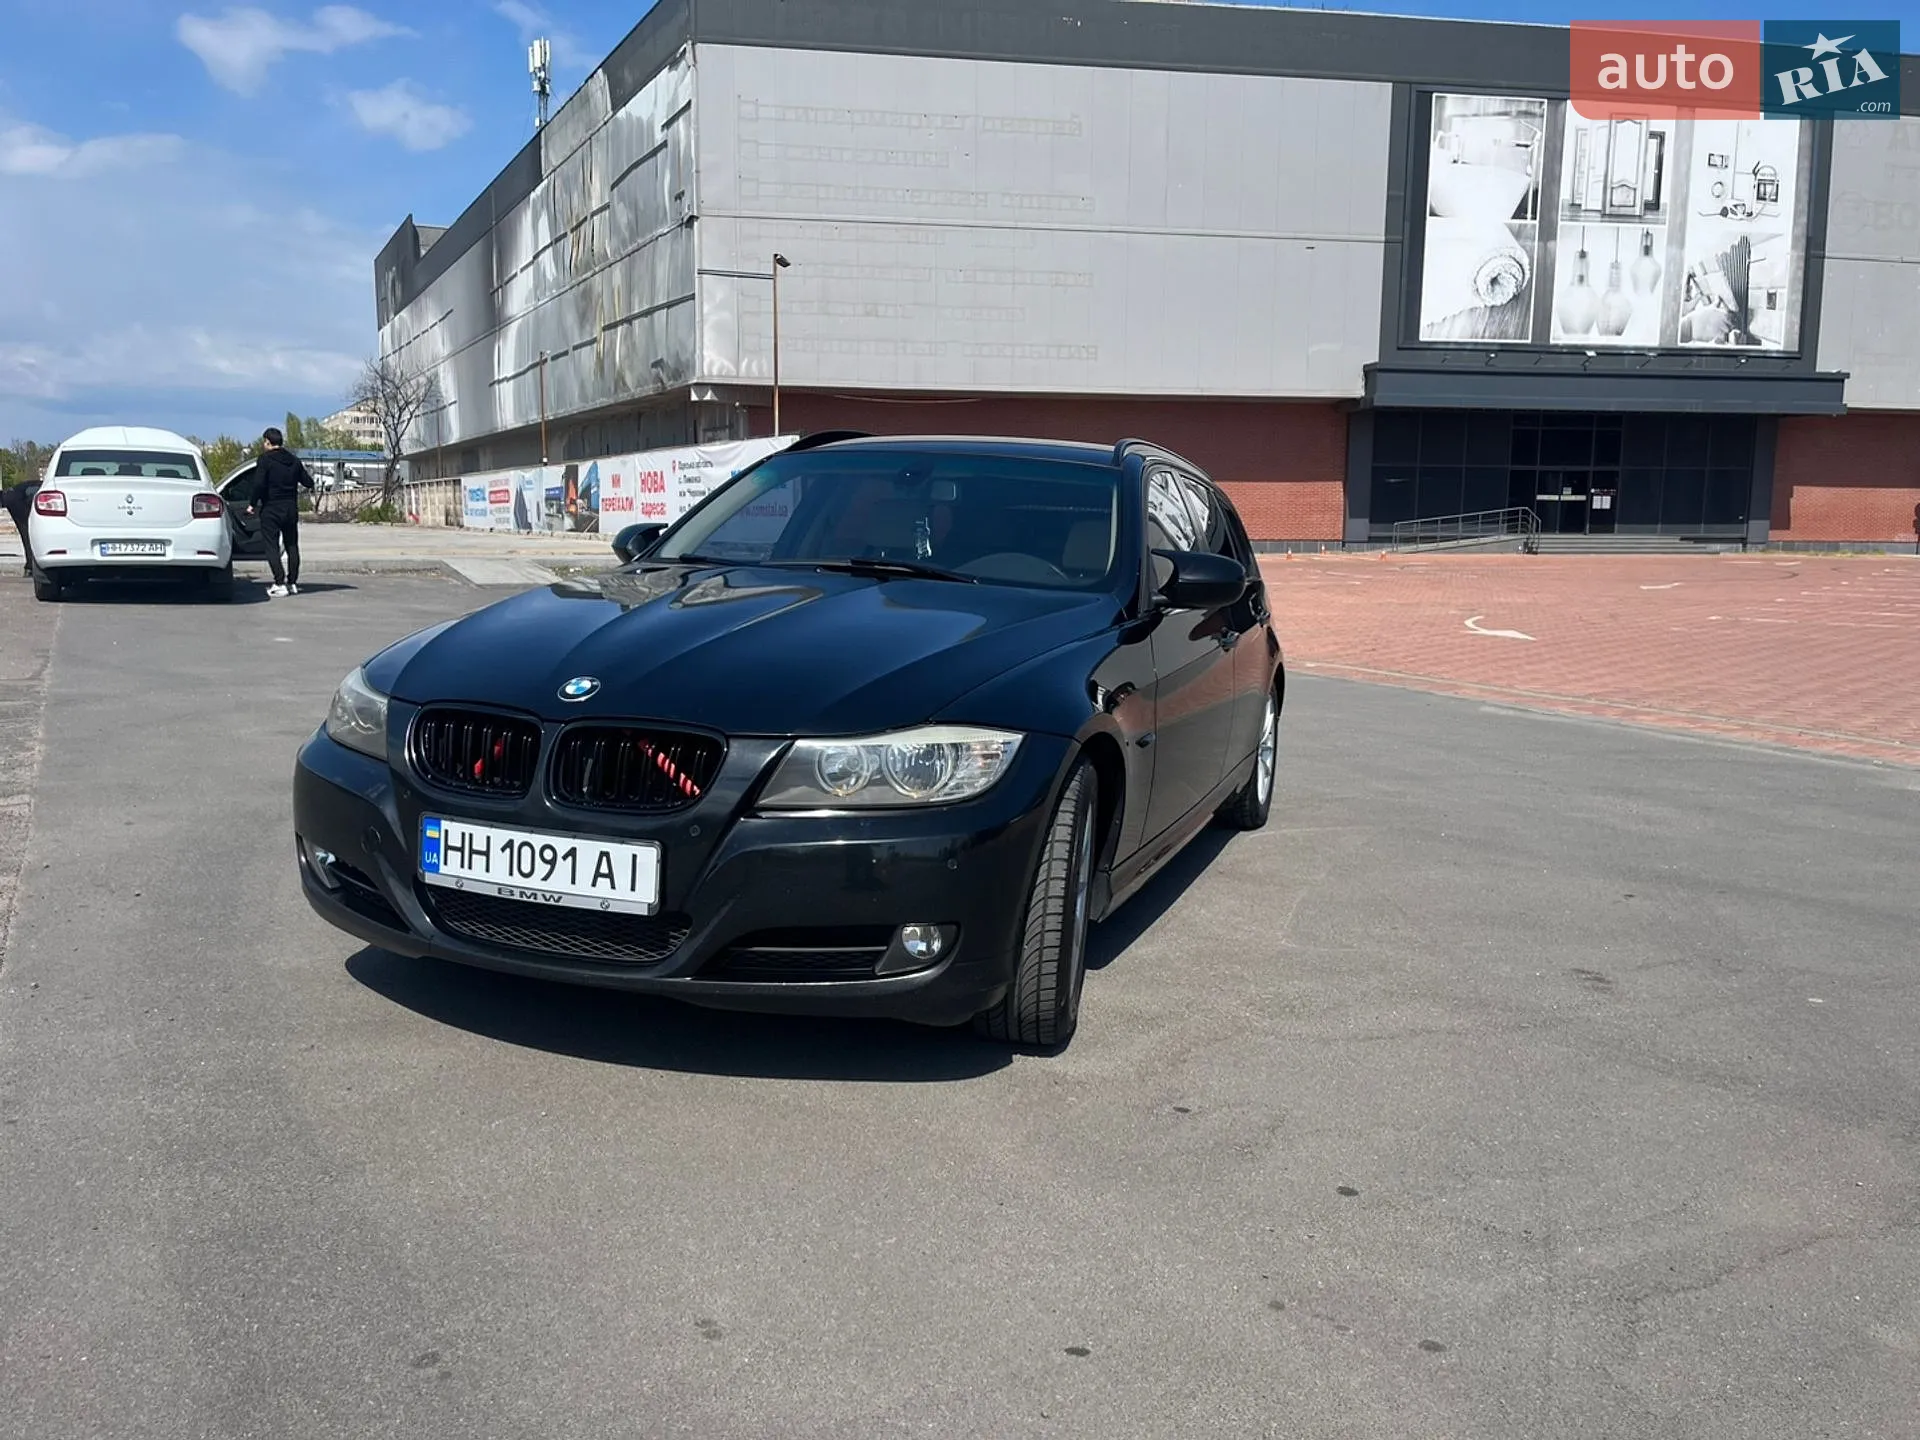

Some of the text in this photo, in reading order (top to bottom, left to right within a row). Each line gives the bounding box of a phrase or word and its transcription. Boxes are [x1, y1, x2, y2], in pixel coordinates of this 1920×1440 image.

[639, 471, 666, 493] НОВА
[425, 853, 438, 864] UA
[443, 828, 638, 892] HH 1091 AI
[497, 886, 563, 904] BMW
